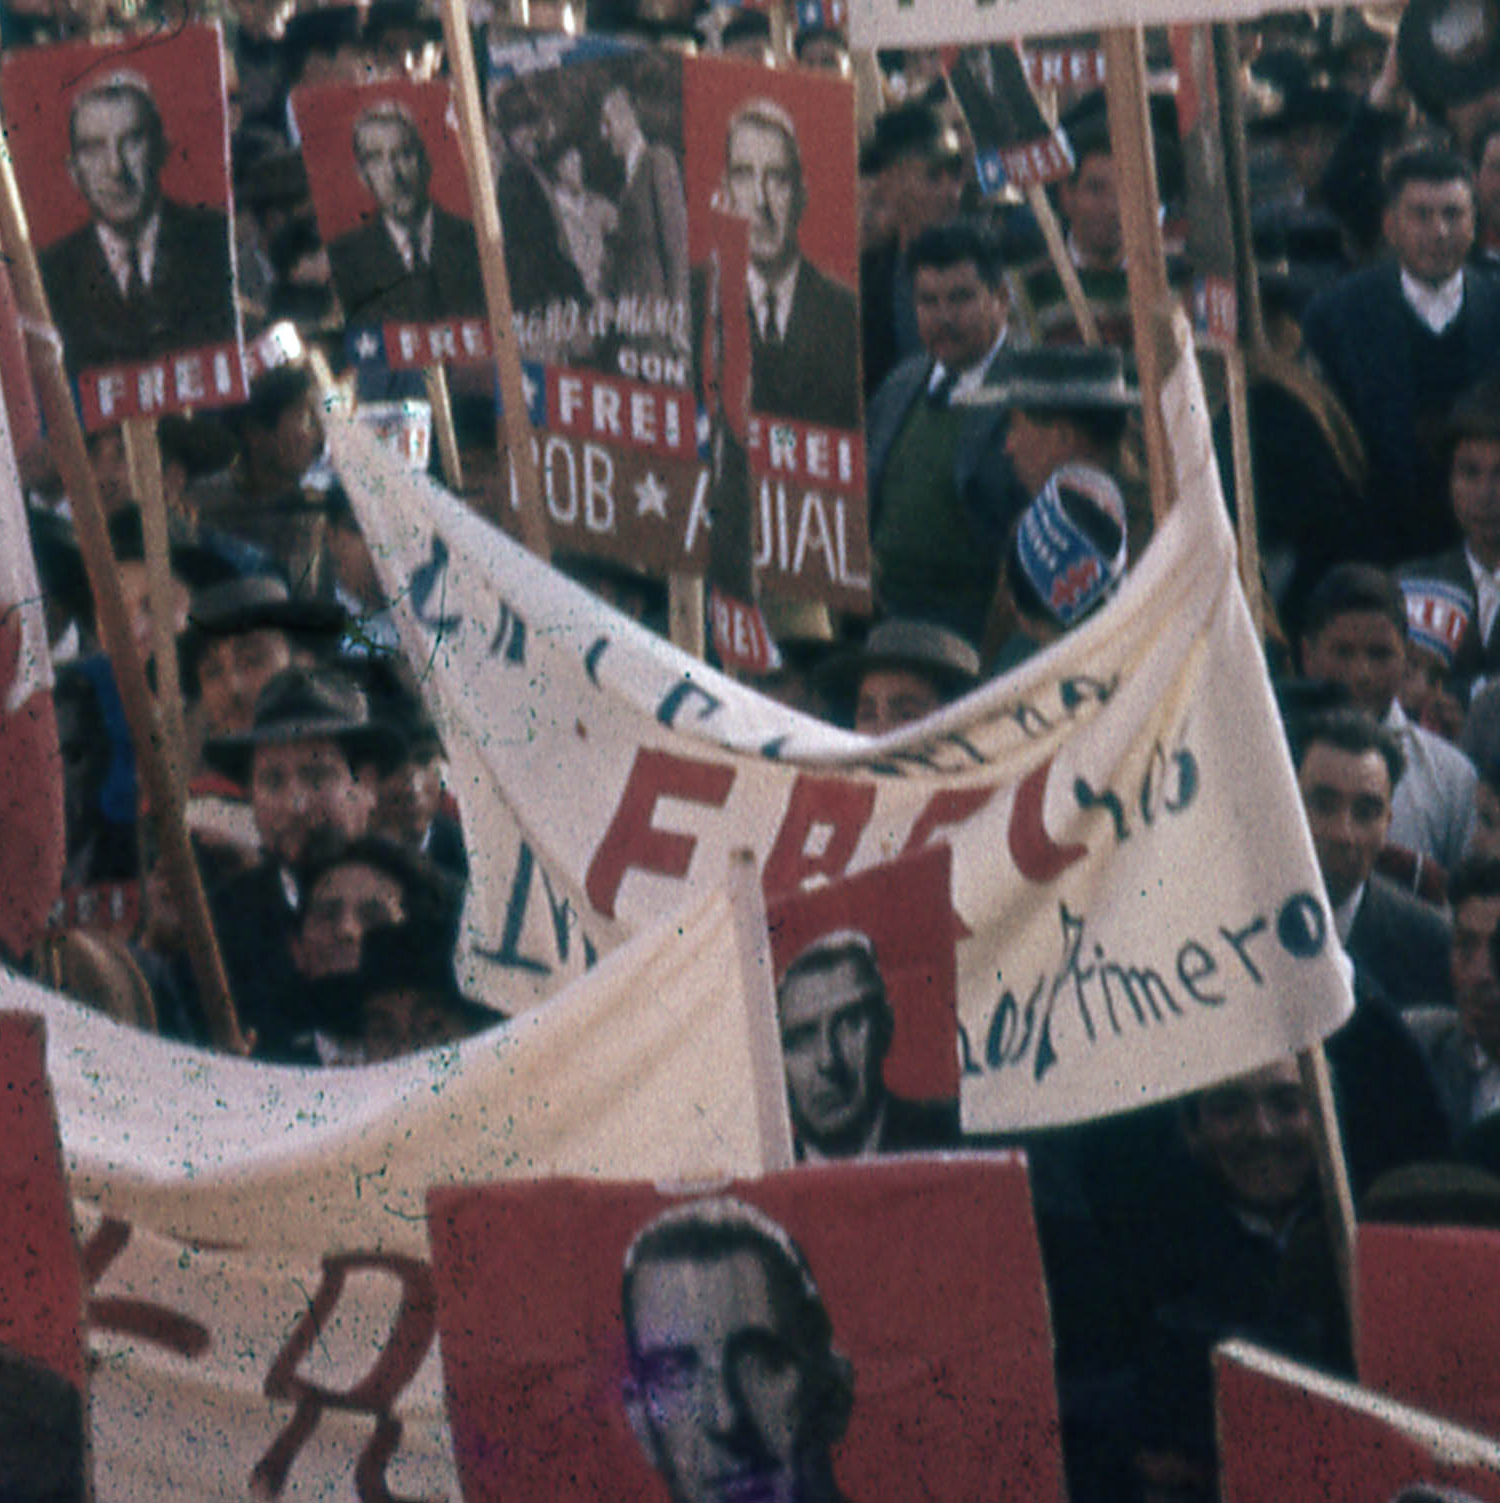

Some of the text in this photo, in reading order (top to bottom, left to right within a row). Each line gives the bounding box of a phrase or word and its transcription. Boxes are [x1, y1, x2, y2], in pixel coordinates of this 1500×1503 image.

[398, 319, 492, 362] FRE
[618, 347, 686, 386] CON
[97, 353, 232, 416] FREI
[558, 374, 682, 448] FREI
[713, 602, 764, 664] REI
